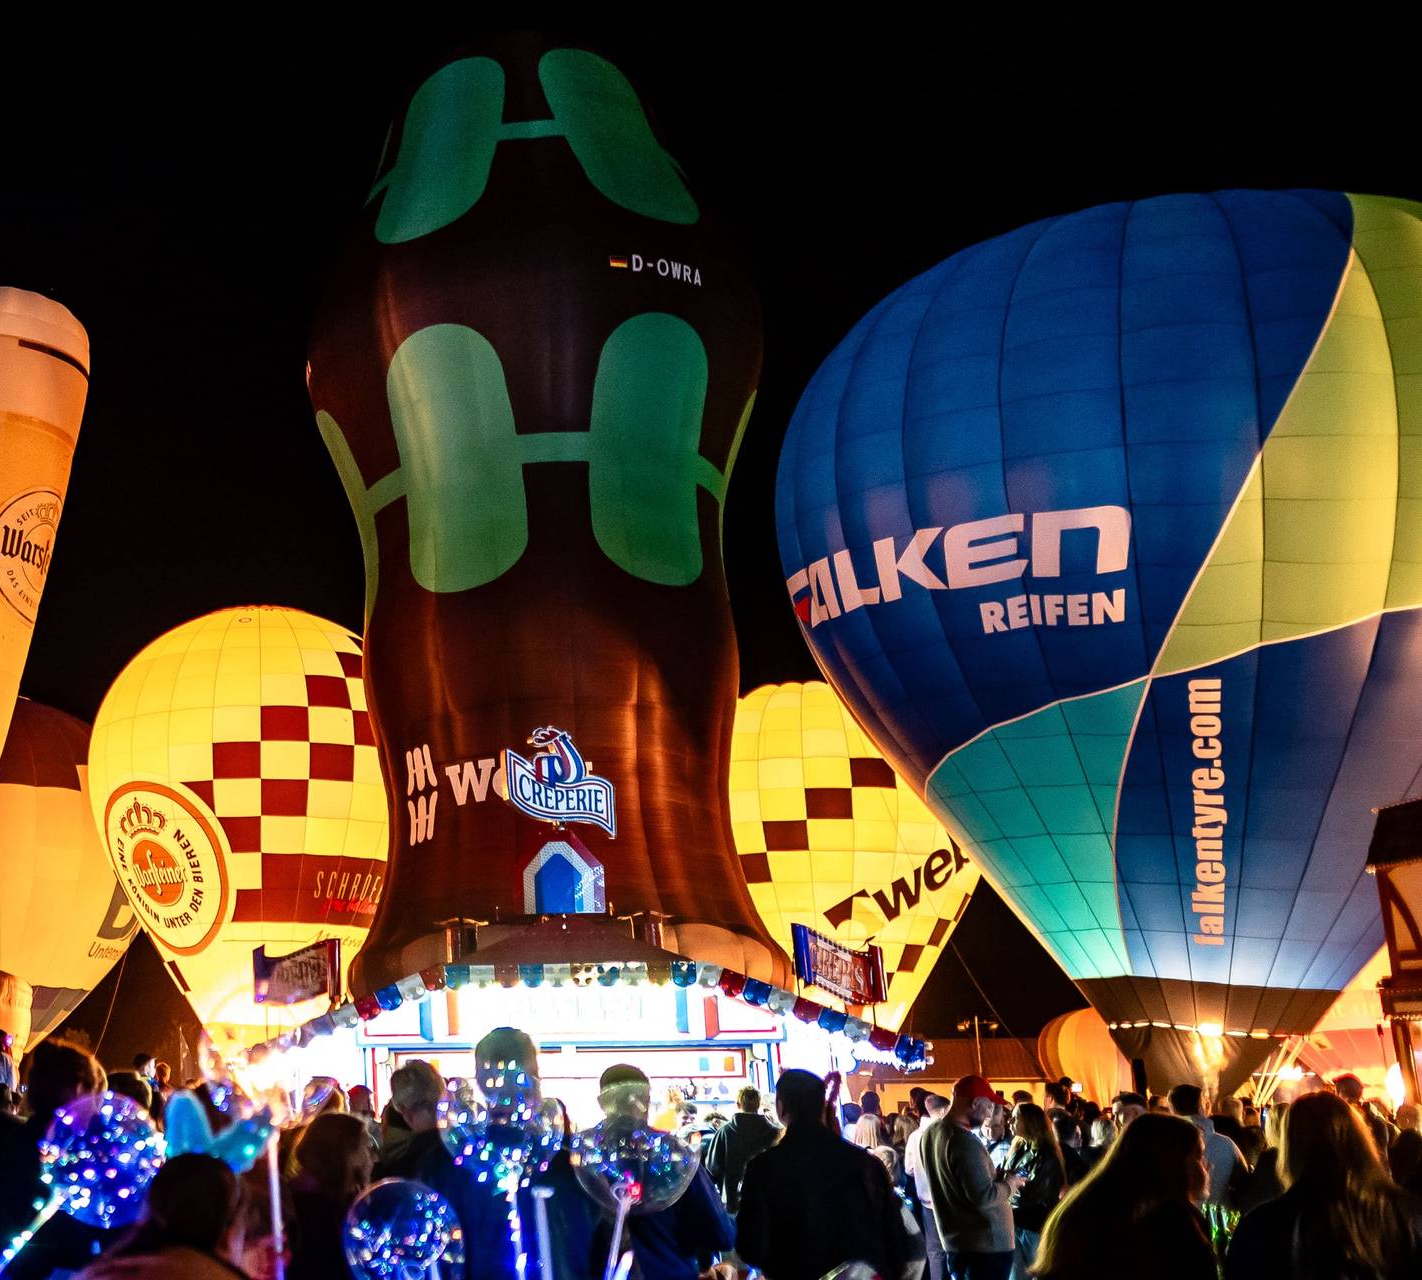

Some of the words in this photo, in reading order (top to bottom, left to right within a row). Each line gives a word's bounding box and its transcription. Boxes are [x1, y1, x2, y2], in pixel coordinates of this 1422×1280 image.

[632, 254, 702, 287] D-OWRA
[17, 508, 35, 526] SEIT
[6, 569, 20, 589] DAS
[786, 505, 1131, 629] FALKEN
[980, 588, 1126, 634] REIFEN
[1188, 678, 1228, 946] falkentyre.com
[173, 828, 204, 883] BIEREN
[189, 888, 204, 913] DEN
[164, 912, 193, 929] UNTER
